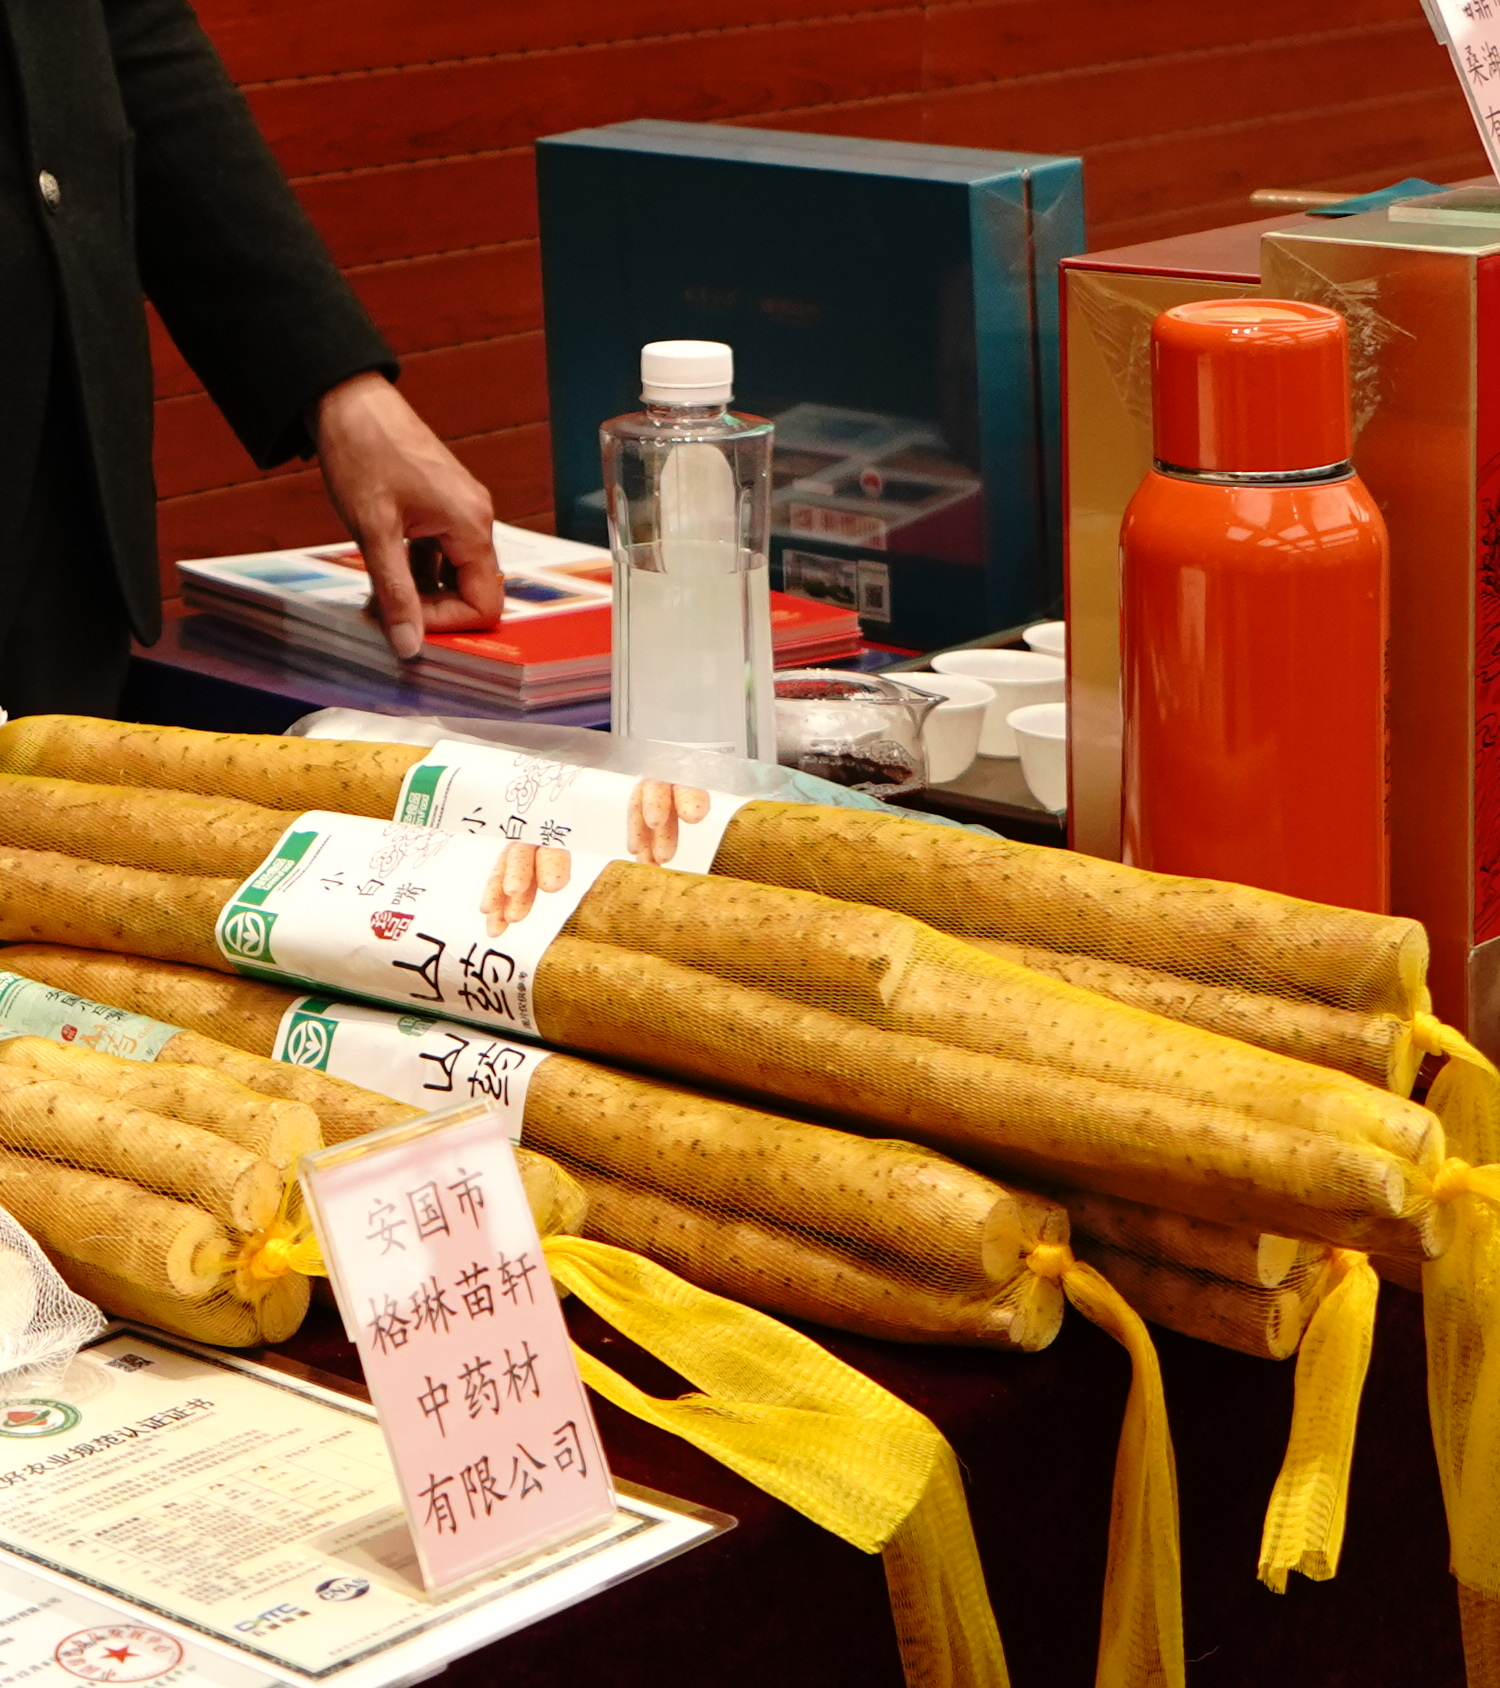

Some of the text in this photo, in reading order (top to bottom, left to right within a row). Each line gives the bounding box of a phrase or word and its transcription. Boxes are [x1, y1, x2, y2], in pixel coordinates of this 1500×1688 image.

[461, 807, 572, 846] 小白嘴
[319, 871, 427, 905] 小白嘴
[391, 932, 515, 1020] 山药
[419, 1032, 526, 1107] 山药
[365, 1166, 486, 1256] 安国市
[367, 1250, 537, 1357] 格琳苗轩
[417, 1339, 542, 1439] 中药材
[417, 1419, 589, 1536] 有限公司
[317, 1577, 370, 1601] CNAS
